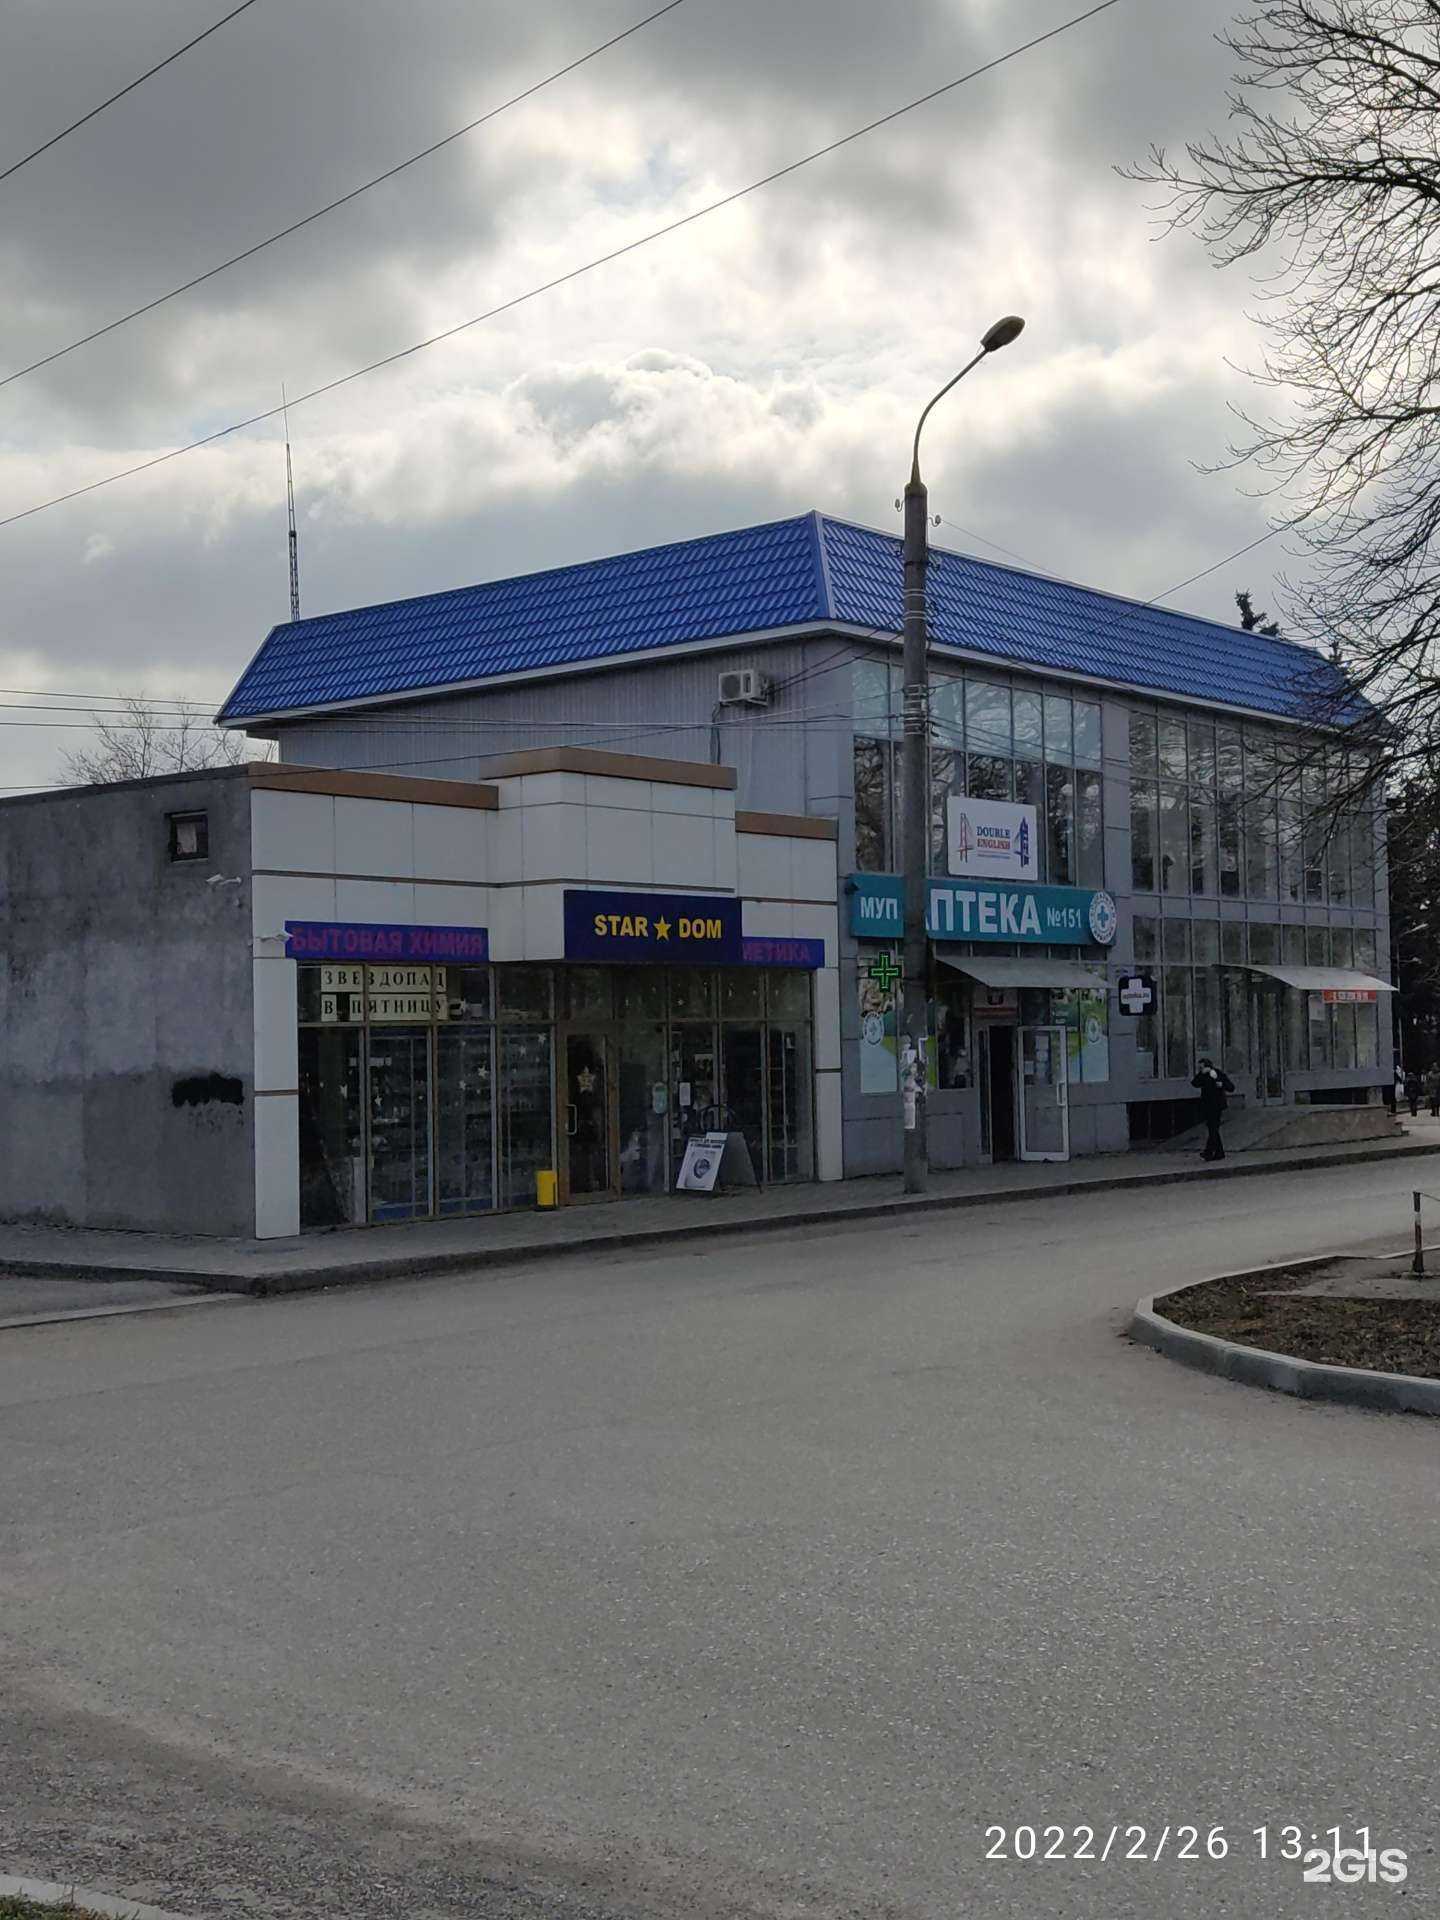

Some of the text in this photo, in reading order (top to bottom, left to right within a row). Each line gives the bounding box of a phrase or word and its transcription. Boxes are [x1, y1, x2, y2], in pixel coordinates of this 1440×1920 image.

[976, 826, 1011, 839] DOUBLE
[977, 838, 1011, 850] ENGLISH
[860, 896, 898, 920] МУП
[925, 888, 1042, 935] ПТЕКА
[1047, 907, 1081, 929] №151
[594, 914, 722, 939] STAR DOM
[290, 927, 482, 956] БЫТОВАЯ ХИМИЯ
[324, 1001, 334, 1014] В
